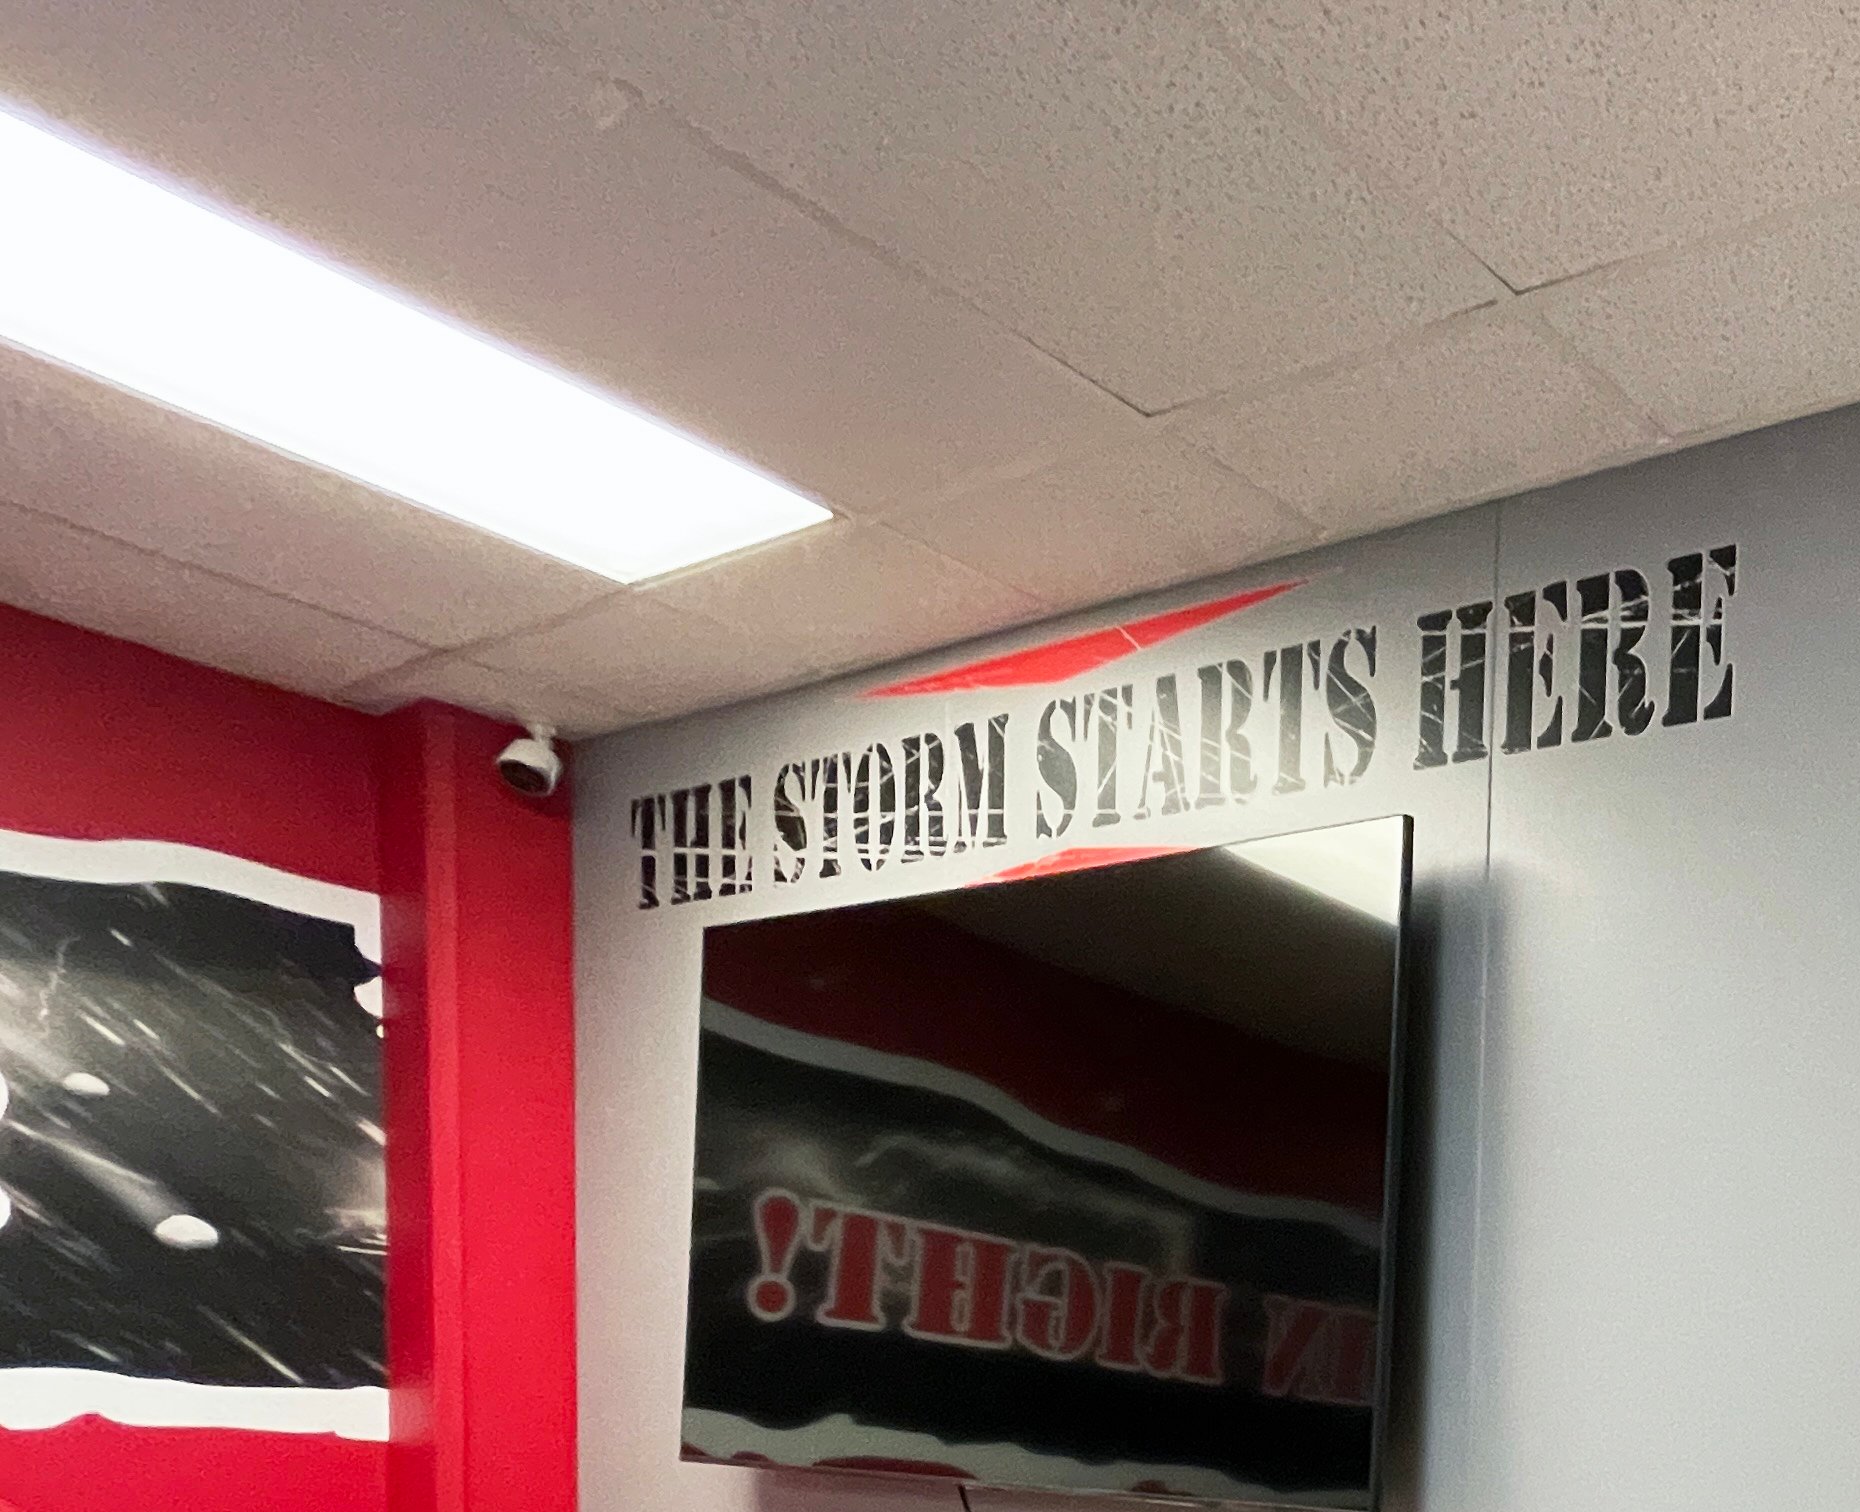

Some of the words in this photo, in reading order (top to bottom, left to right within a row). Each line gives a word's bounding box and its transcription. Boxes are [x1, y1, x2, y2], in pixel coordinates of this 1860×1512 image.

[630, 773, 754, 910] THE
[772, 711, 1009, 886] STORM
[1034, 624, 1380, 840] STARTS
[1411, 544, 1740, 772] HERE
